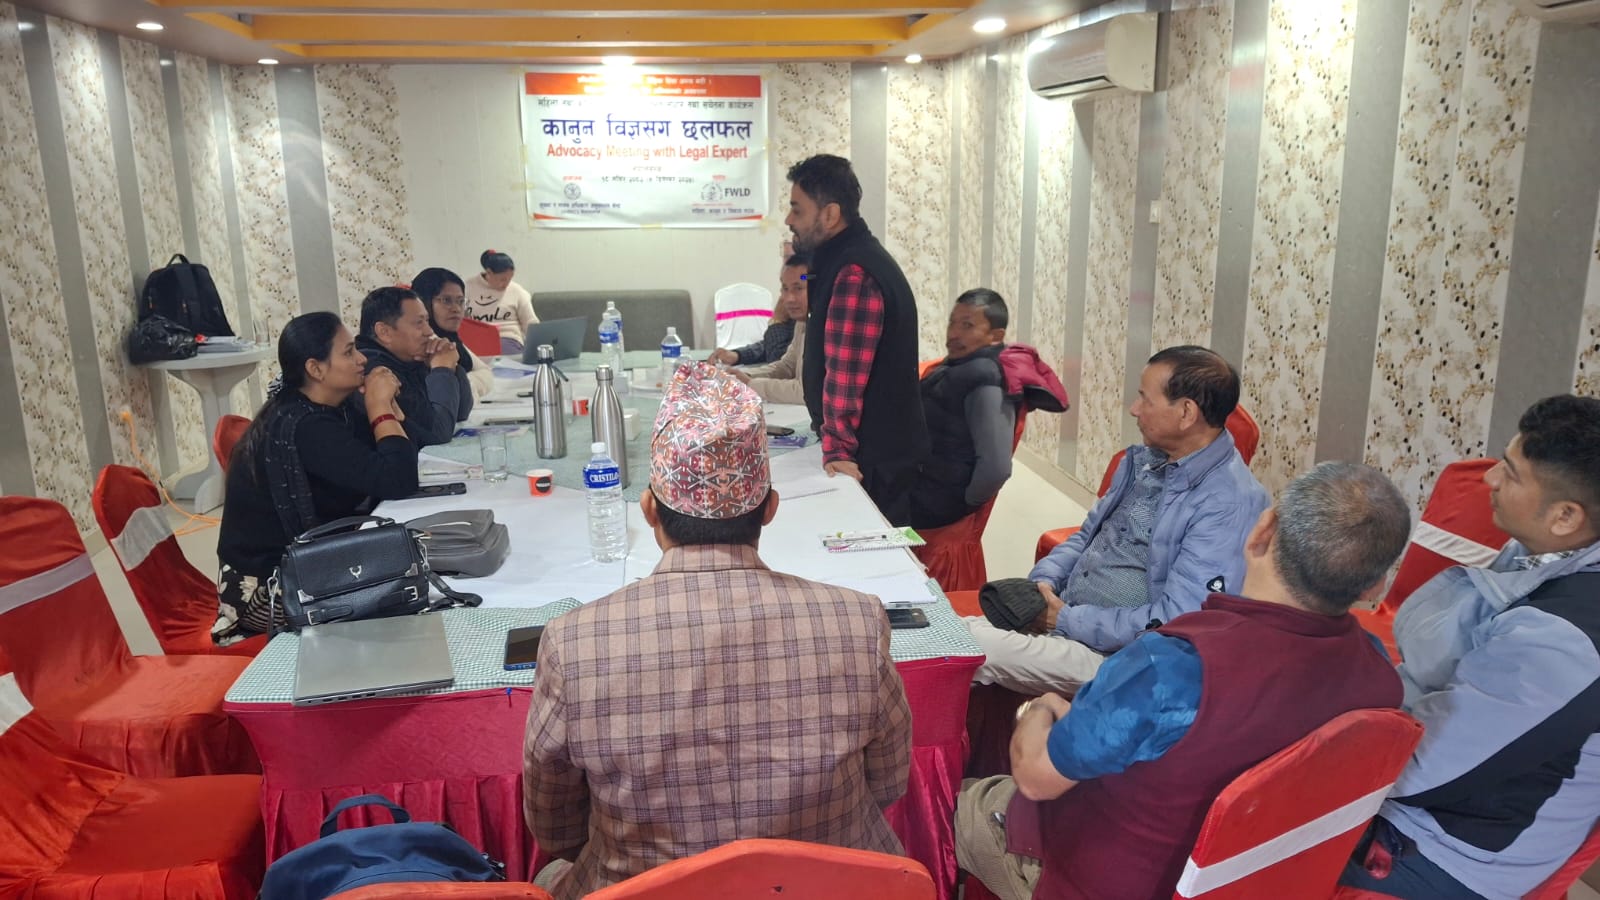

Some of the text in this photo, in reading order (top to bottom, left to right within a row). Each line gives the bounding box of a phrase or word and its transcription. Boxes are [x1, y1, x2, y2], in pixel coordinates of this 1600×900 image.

[540, 118, 596, 144] कानुन
[680, 120, 754, 141] छलफल
[546, 143, 748, 162] Advocacy Meeting with Legal Expert
[725, 188, 751, 197] FWLD
